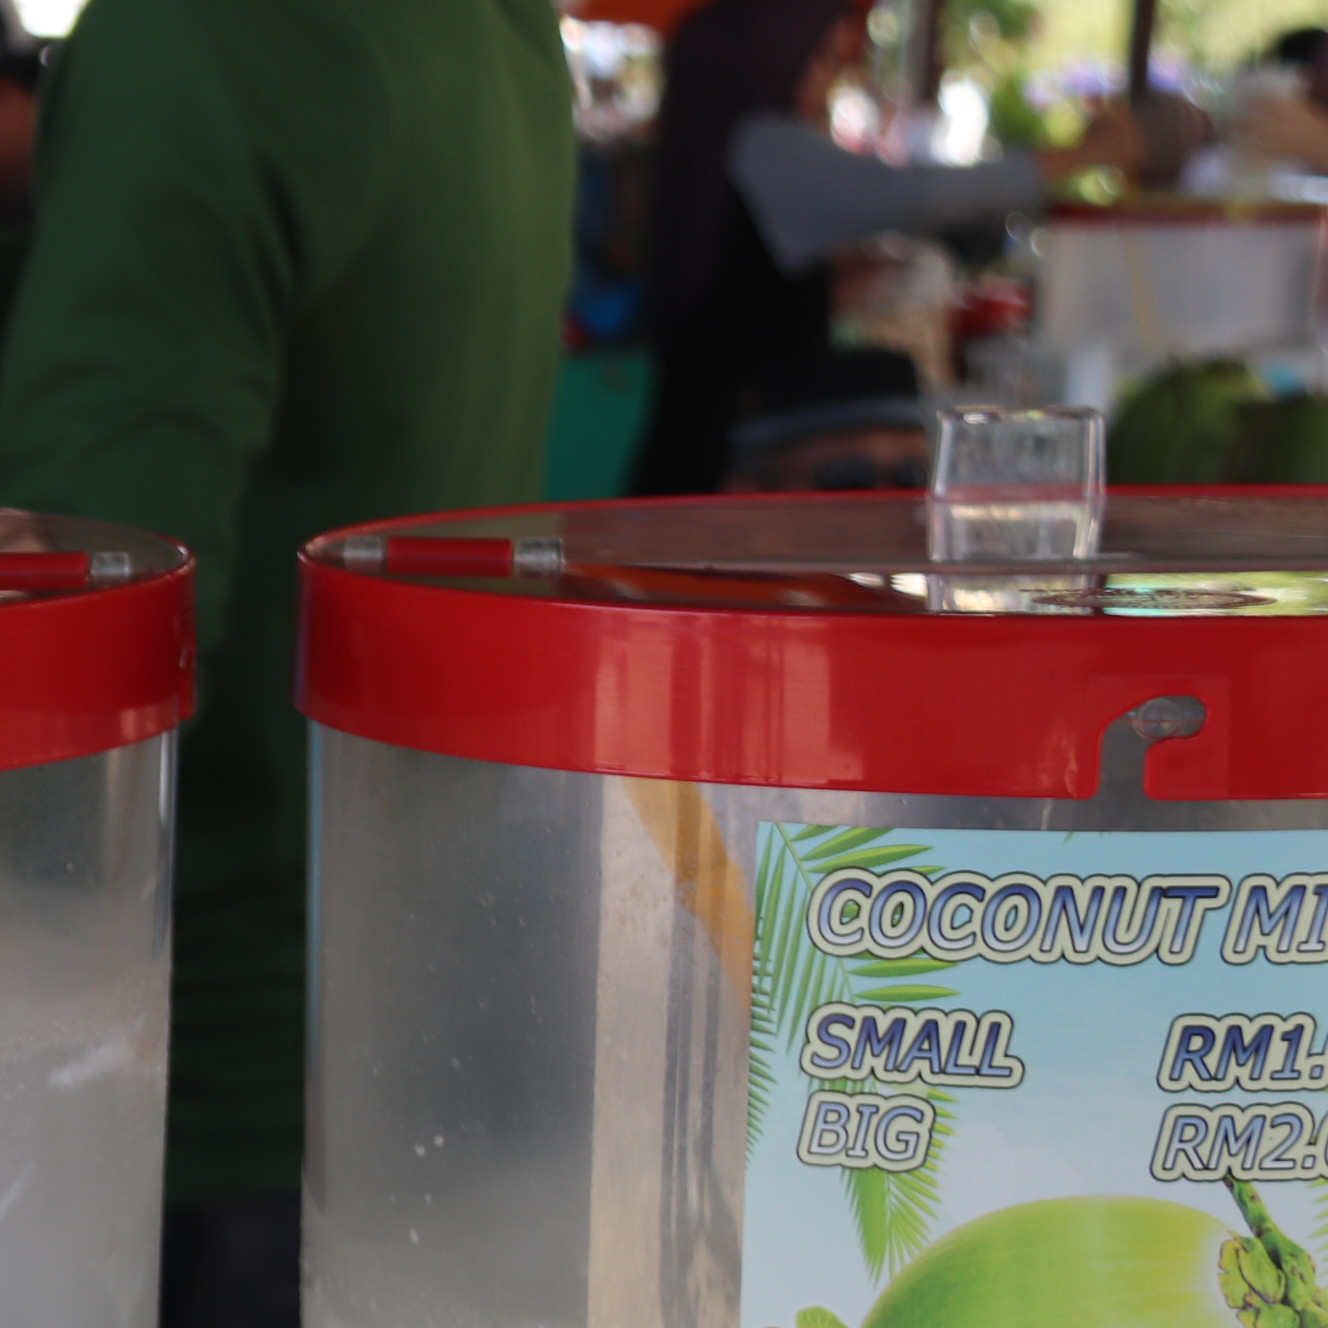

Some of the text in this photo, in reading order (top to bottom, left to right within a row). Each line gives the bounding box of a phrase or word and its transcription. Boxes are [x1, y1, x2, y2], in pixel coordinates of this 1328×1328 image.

[812, 873, 1226, 960] COCONUT
[806, 1008, 1018, 1082] SMALL
[803, 1096, 1328, 1176] BIG RM2.
